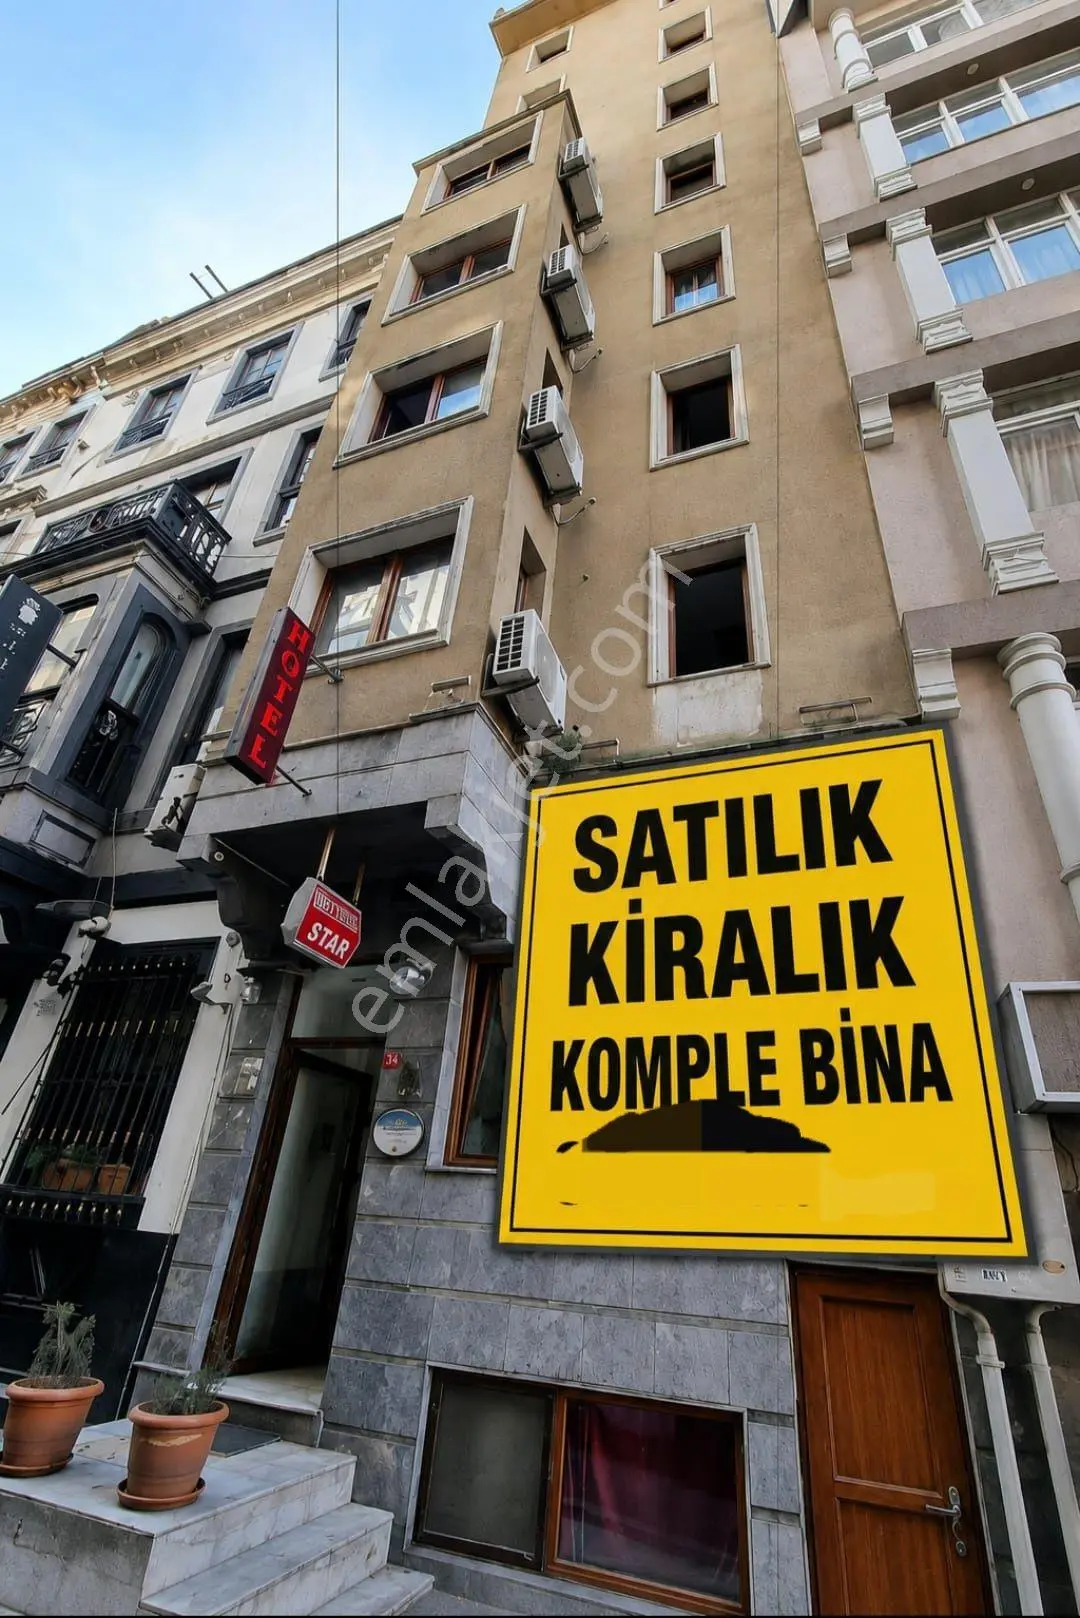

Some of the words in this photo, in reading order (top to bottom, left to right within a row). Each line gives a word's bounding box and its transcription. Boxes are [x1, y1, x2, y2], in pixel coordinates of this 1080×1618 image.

[248, 619, 311, 769] HOTEL
[573, 779, 893, 893] SATILIK
[307, 922, 350, 959] STAR
[568, 896, 916, 1007] KİRALIK
[385, 1054, 398, 1065] 34
[550, 1029, 780, 1111] KOMPLE
[799, 1007, 953, 1105] BİNA
